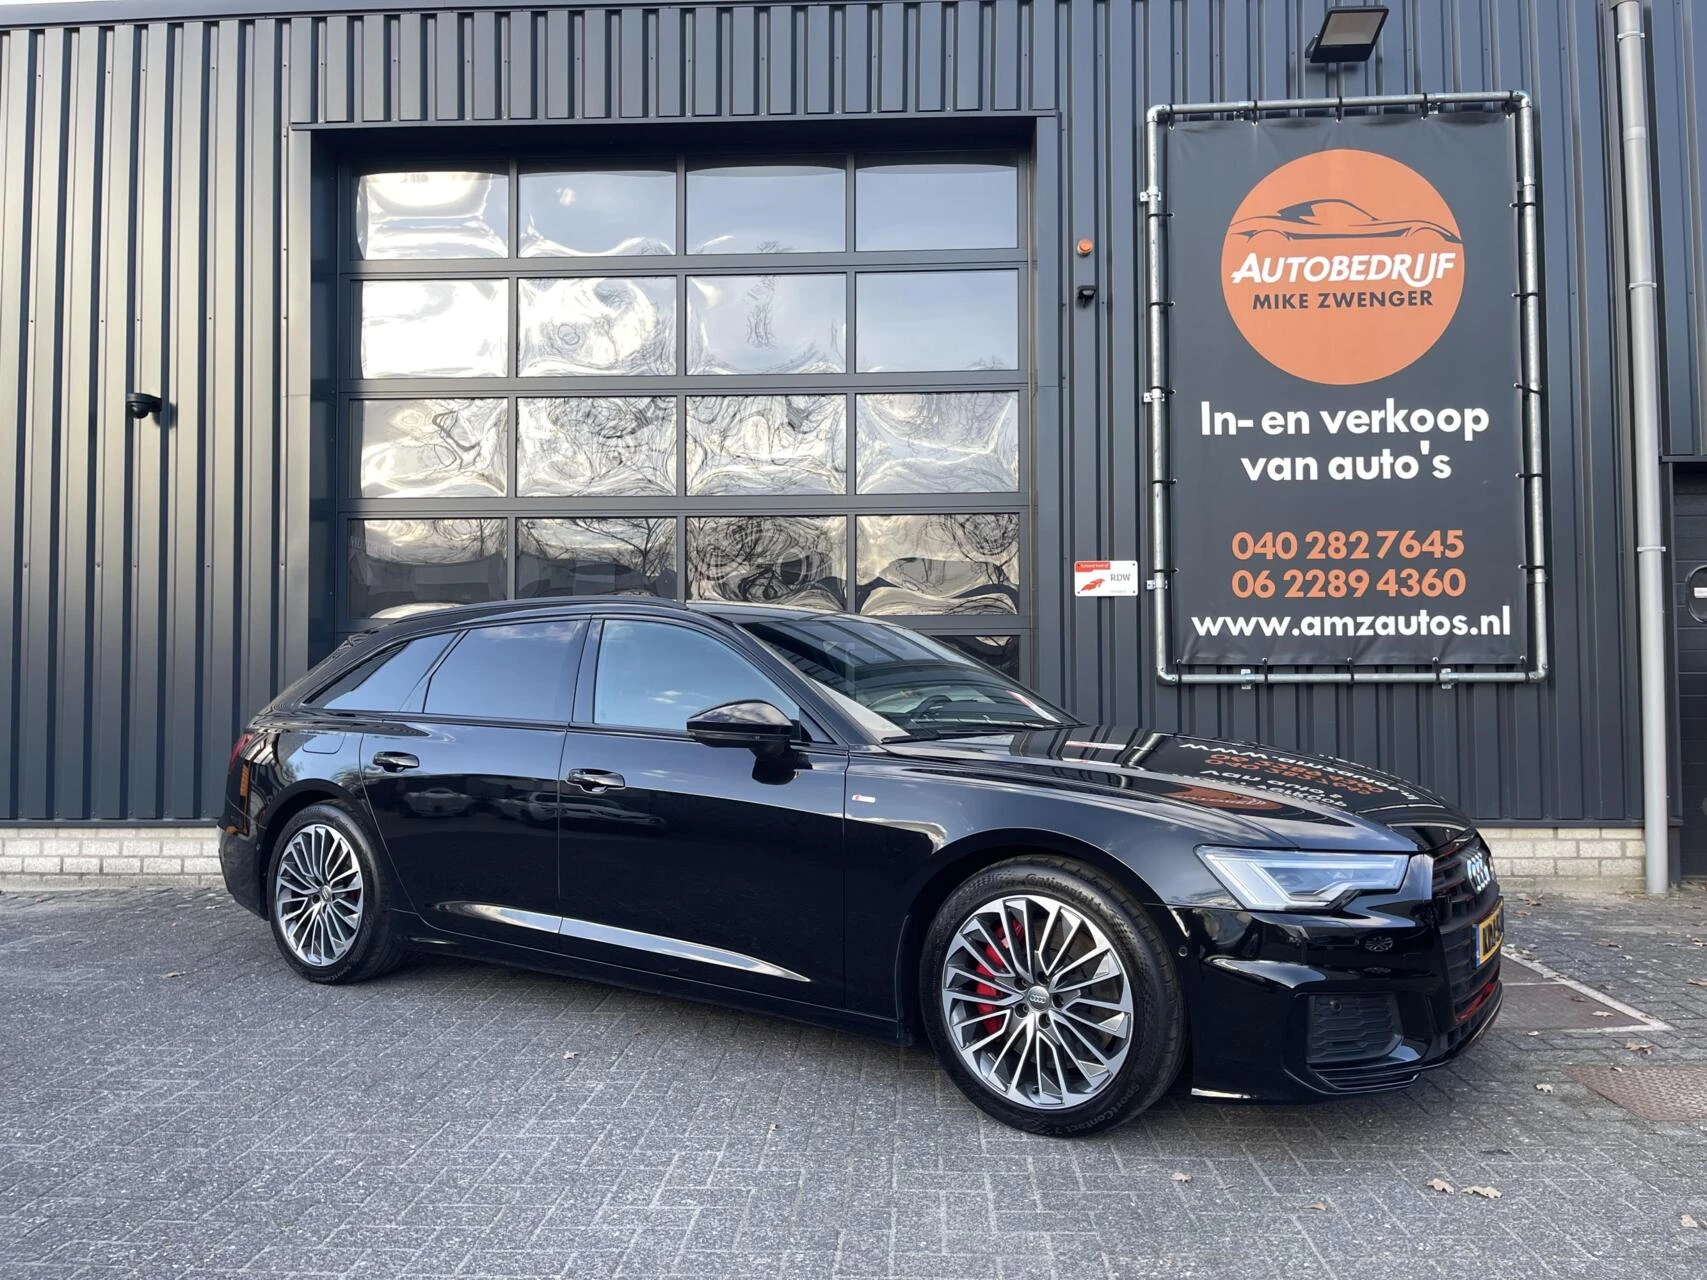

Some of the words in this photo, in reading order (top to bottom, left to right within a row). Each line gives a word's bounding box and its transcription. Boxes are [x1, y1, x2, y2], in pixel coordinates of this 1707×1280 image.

[1230, 252, 1457, 288] AUTOBEDRIJF
[1252, 293, 1309, 310] MIKE
[1317, 289, 1433, 309] ZWENGER
[1200, 400, 1254, 436] In-
[1261, 410, 1310, 436] en
[1319, 397, 1490, 442] verkoop
[1240, 456, 1319, 482] van
[1327, 439, 1452, 481] auto's
[1231, 531, 1298, 561] 040
[1305, 530, 1370, 560] 282
[1375, 529, 1465, 559] 7645
[1110, 573, 1131, 582] RDW
[1231, 570, 1276, 599] 06
[1283, 568, 1370, 598] 2289
[1375, 567, 1467, 597] 4360
[1190, 605, 1511, 637] www.amzautos.nl
